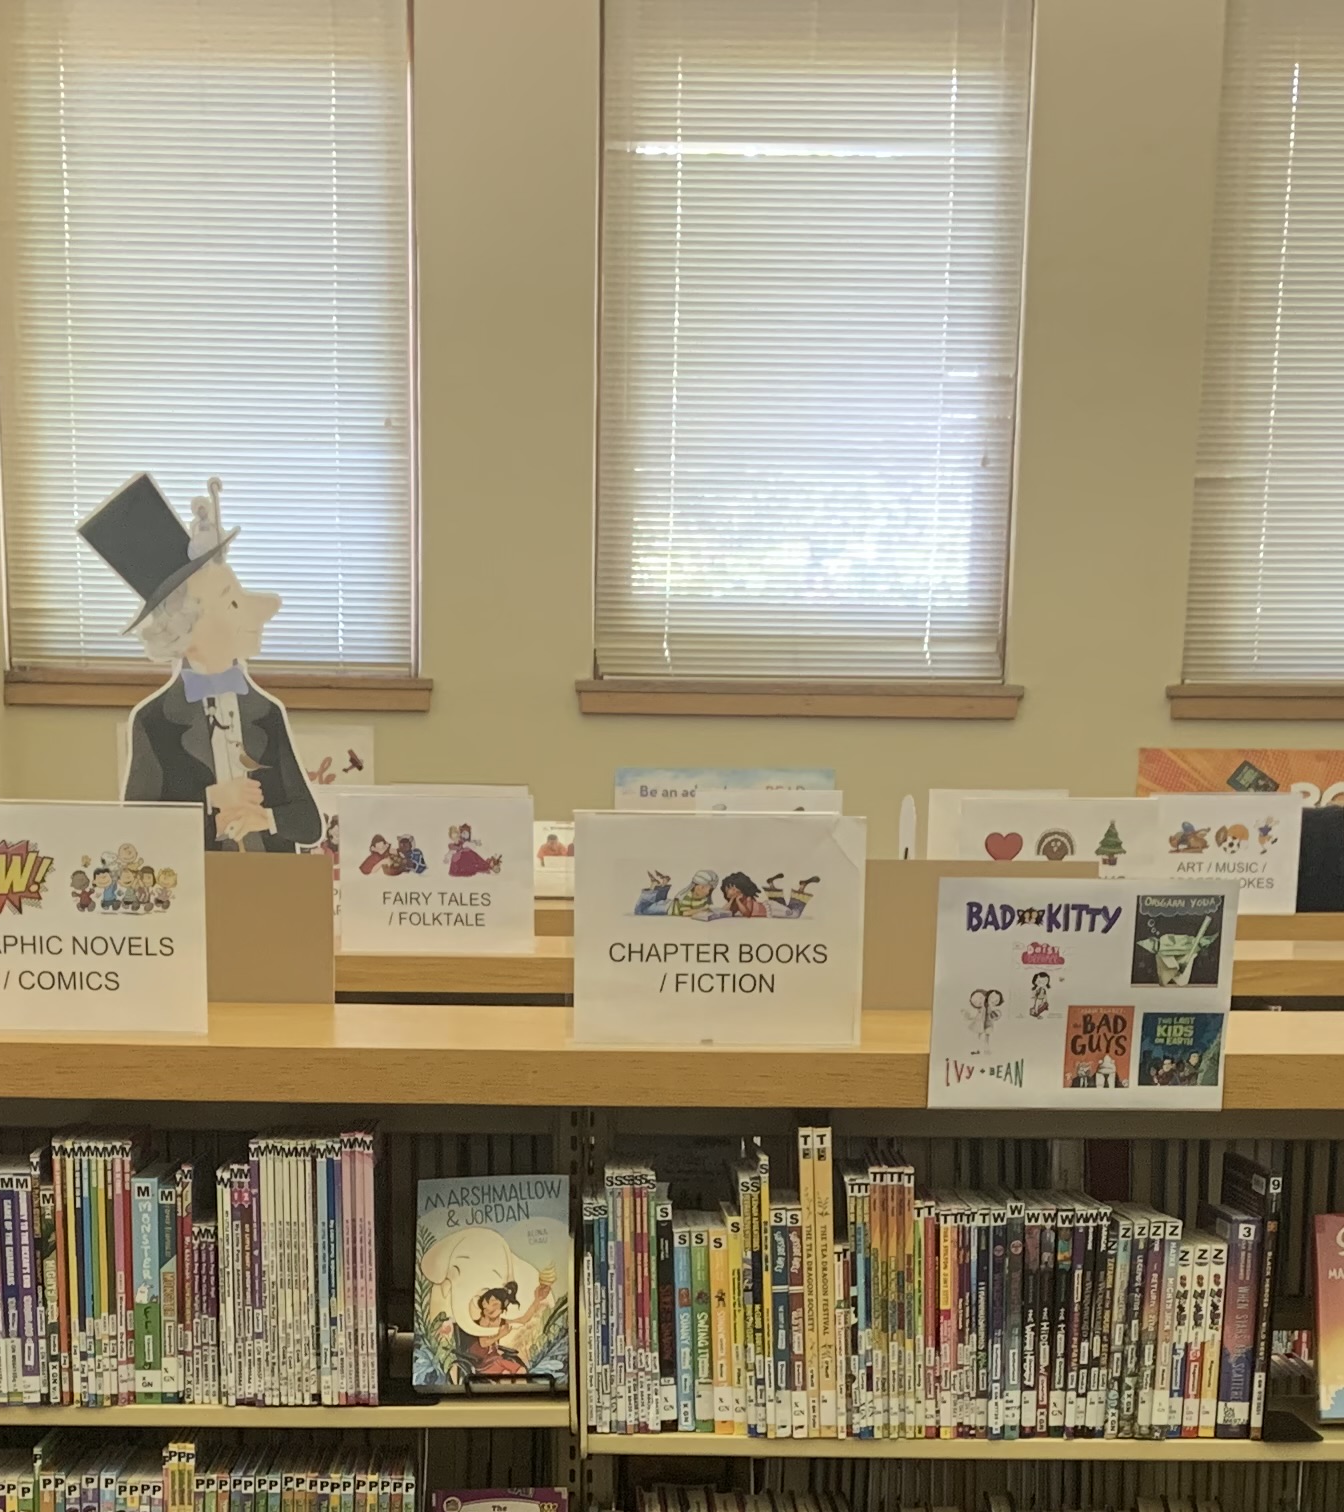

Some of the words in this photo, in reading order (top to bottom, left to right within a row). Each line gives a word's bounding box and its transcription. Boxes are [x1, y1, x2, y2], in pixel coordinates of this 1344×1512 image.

[639, 784, 657, 798] Be
[661, 787, 678, 798] an
[1176, 861, 1204, 873] ART
[1215, 861, 1259, 874] MUSIC
[382, 891, 432, 907] FAIRY
[436, 891, 492, 908] TALES
[398, 911, 487, 928] FOLKTALE
[966, 901, 1016, 933] BAD
[1046, 902, 1123, 934] KITTY
[70, 934, 175, 958] NOVELS
[608, 942, 730, 965] CHAPTER
[738, 942, 829, 965] BOOKS
[16, 969, 121, 993] COMICS
[674, 973, 777, 994] FICTION
[1082, 1013, 1128, 1035] BAD
[1156, 1024, 1195, 1038] KIDS
[1070, 1033, 1128, 1056] GUYS
[1166, 1037, 1195, 1046] EARTH
[989, 1057, 1025, 1088] BEAN
[424, 1177, 563, 1211] MARSHMALLOW
[465, 1201, 531, 1227] JORDAN
[491, 1504, 508, 1512] The
